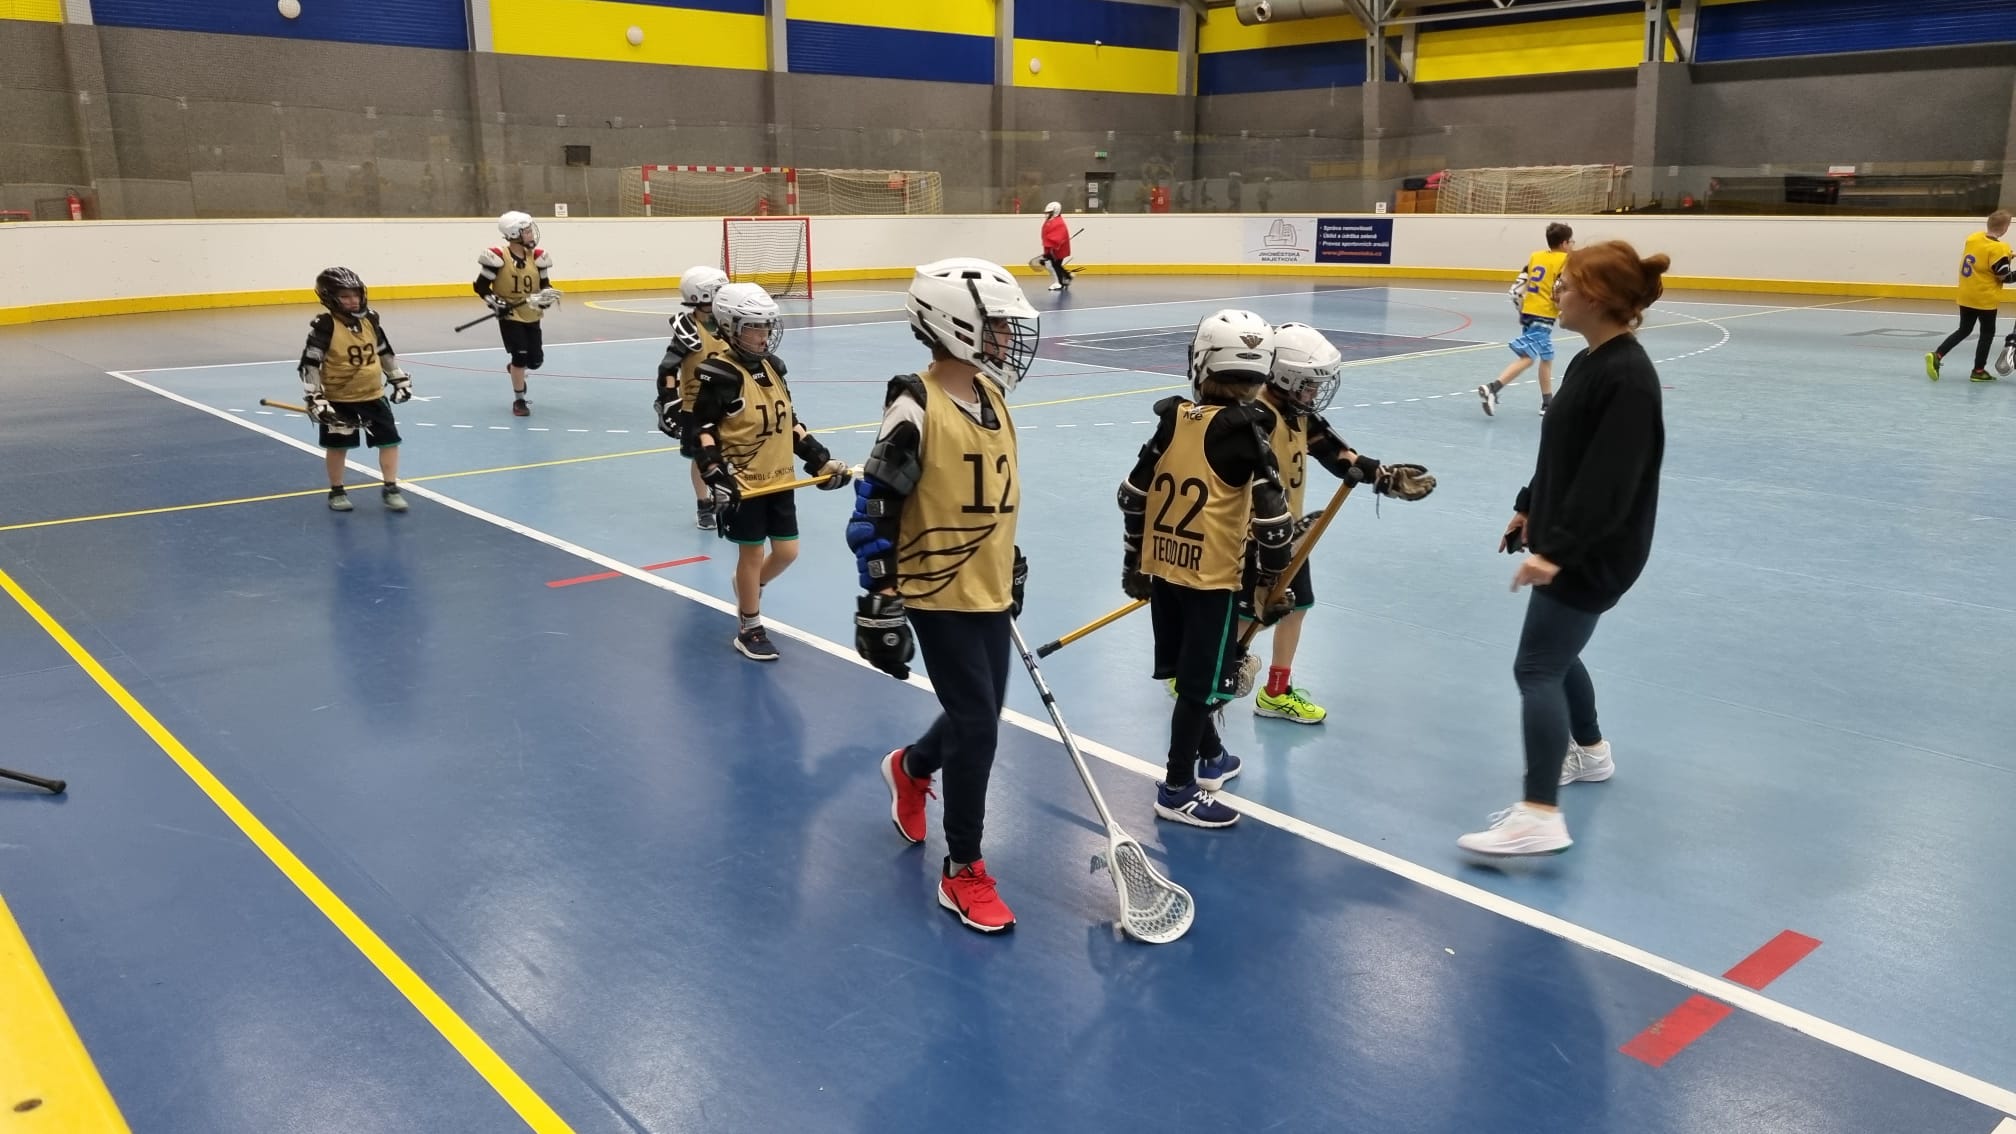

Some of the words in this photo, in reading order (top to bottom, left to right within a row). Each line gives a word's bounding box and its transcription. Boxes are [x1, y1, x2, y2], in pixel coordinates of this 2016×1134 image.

[1961, 254, 1976, 278] 6
[511, 275, 533, 294] 19
[347, 343, 376, 367] 82
[756, 400, 787, 438] 16
[961, 453, 1015, 514] 12
[1153, 472, 1209, 541] 22
[1152, 535, 1203, 571] TEODOR
